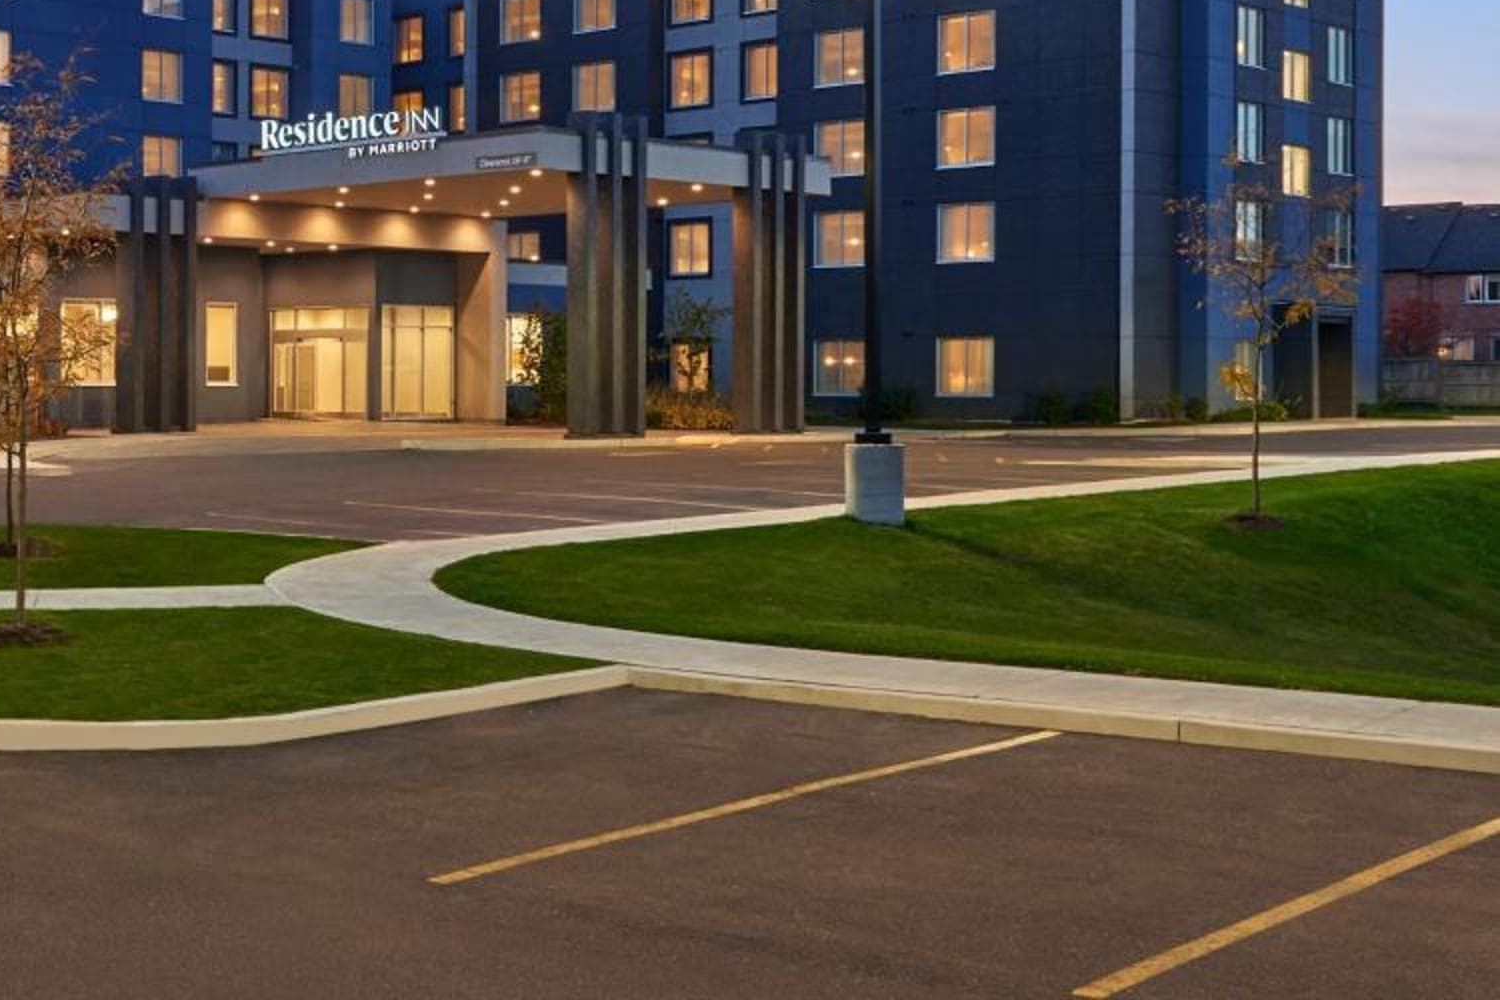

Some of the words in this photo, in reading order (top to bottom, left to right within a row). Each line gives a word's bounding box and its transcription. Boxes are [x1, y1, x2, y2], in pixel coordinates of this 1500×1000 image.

[260, 111, 399, 150] Residence
[404, 107, 440, 136] INN
[349, 147, 365, 158] BY
[369, 138, 436, 156] MARRIOTT
